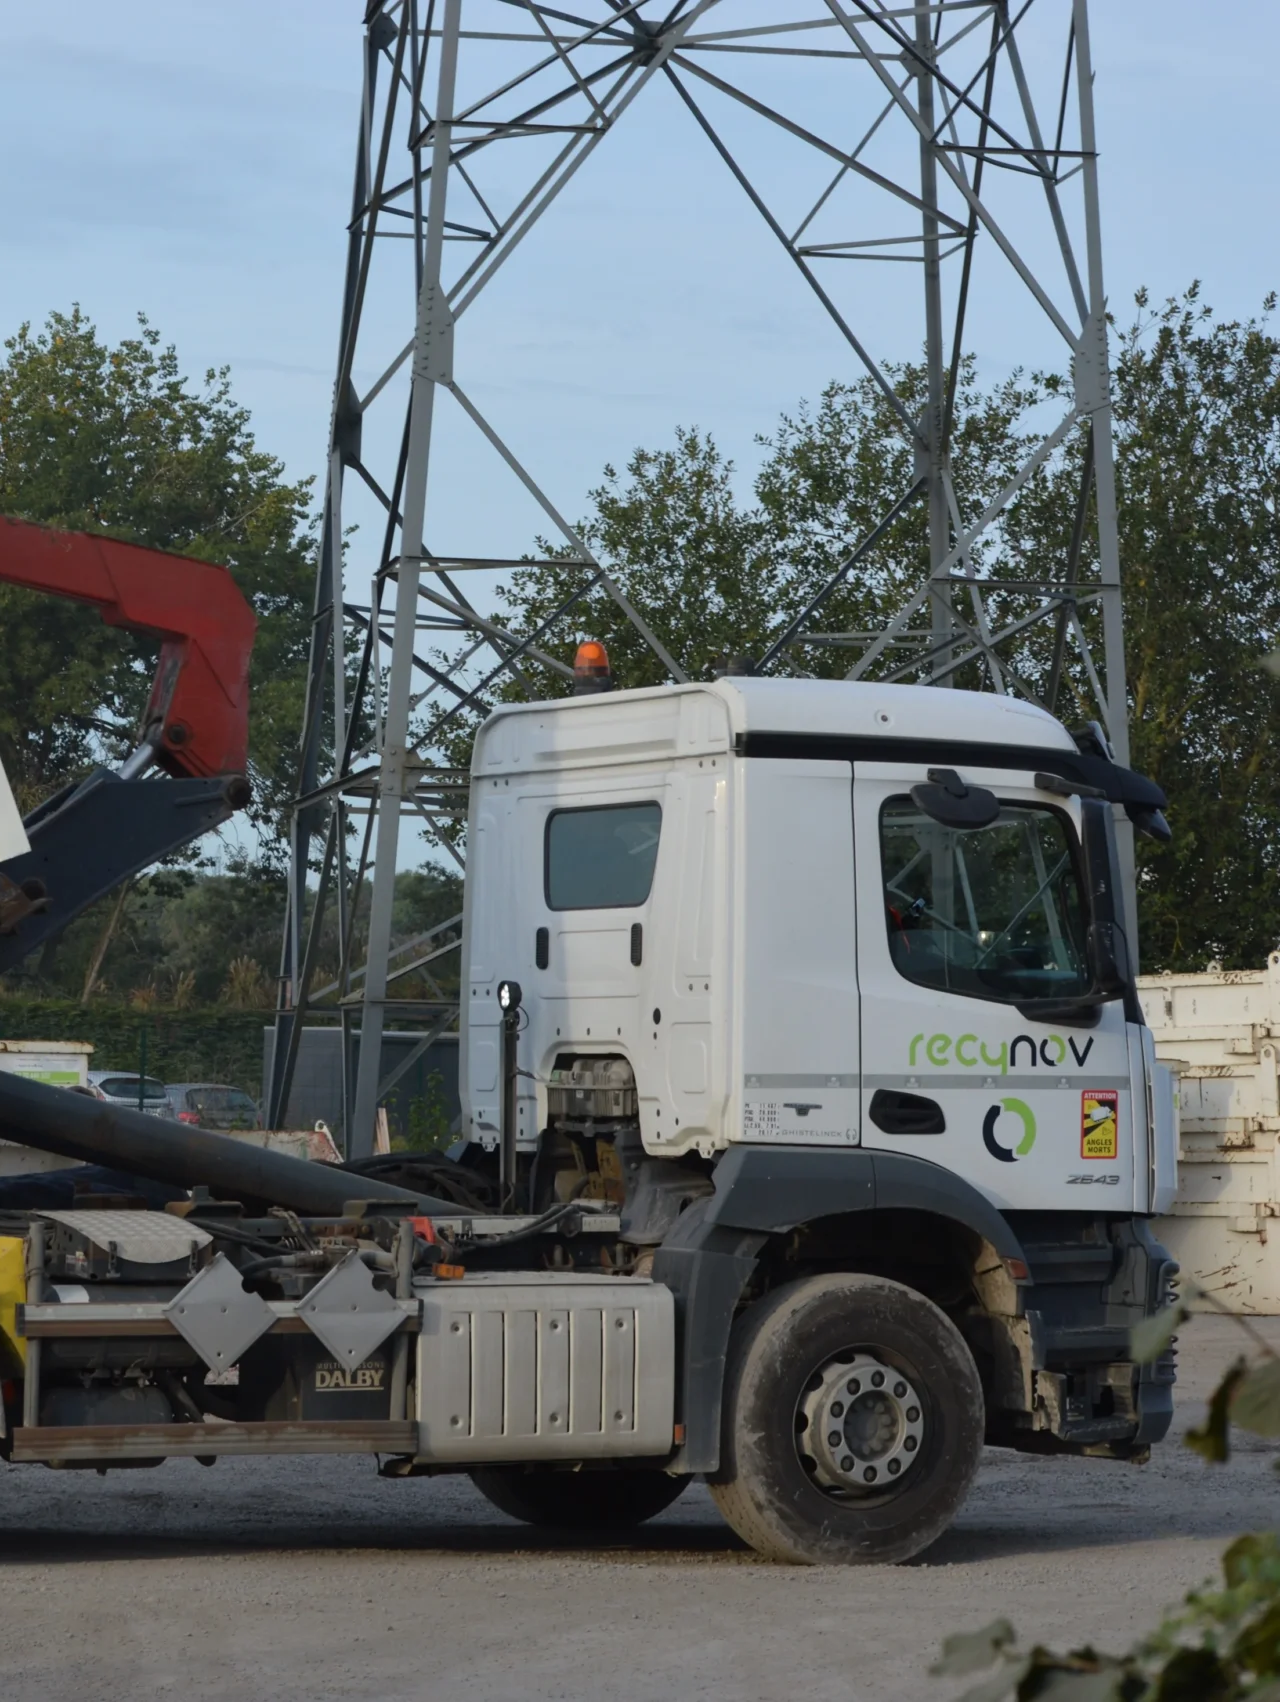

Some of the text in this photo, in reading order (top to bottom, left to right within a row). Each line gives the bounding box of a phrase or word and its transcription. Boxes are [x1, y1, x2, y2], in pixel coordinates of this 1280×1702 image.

[909, 1033, 1095, 1076] recynov
[1083, 1092, 1118, 1100] ATTENTION
[1086, 1138, 1113, 1146] ANGLES
[1087, 1146, 1111, 1154] MORTS
[315, 1369, 385, 1388] DALBY
